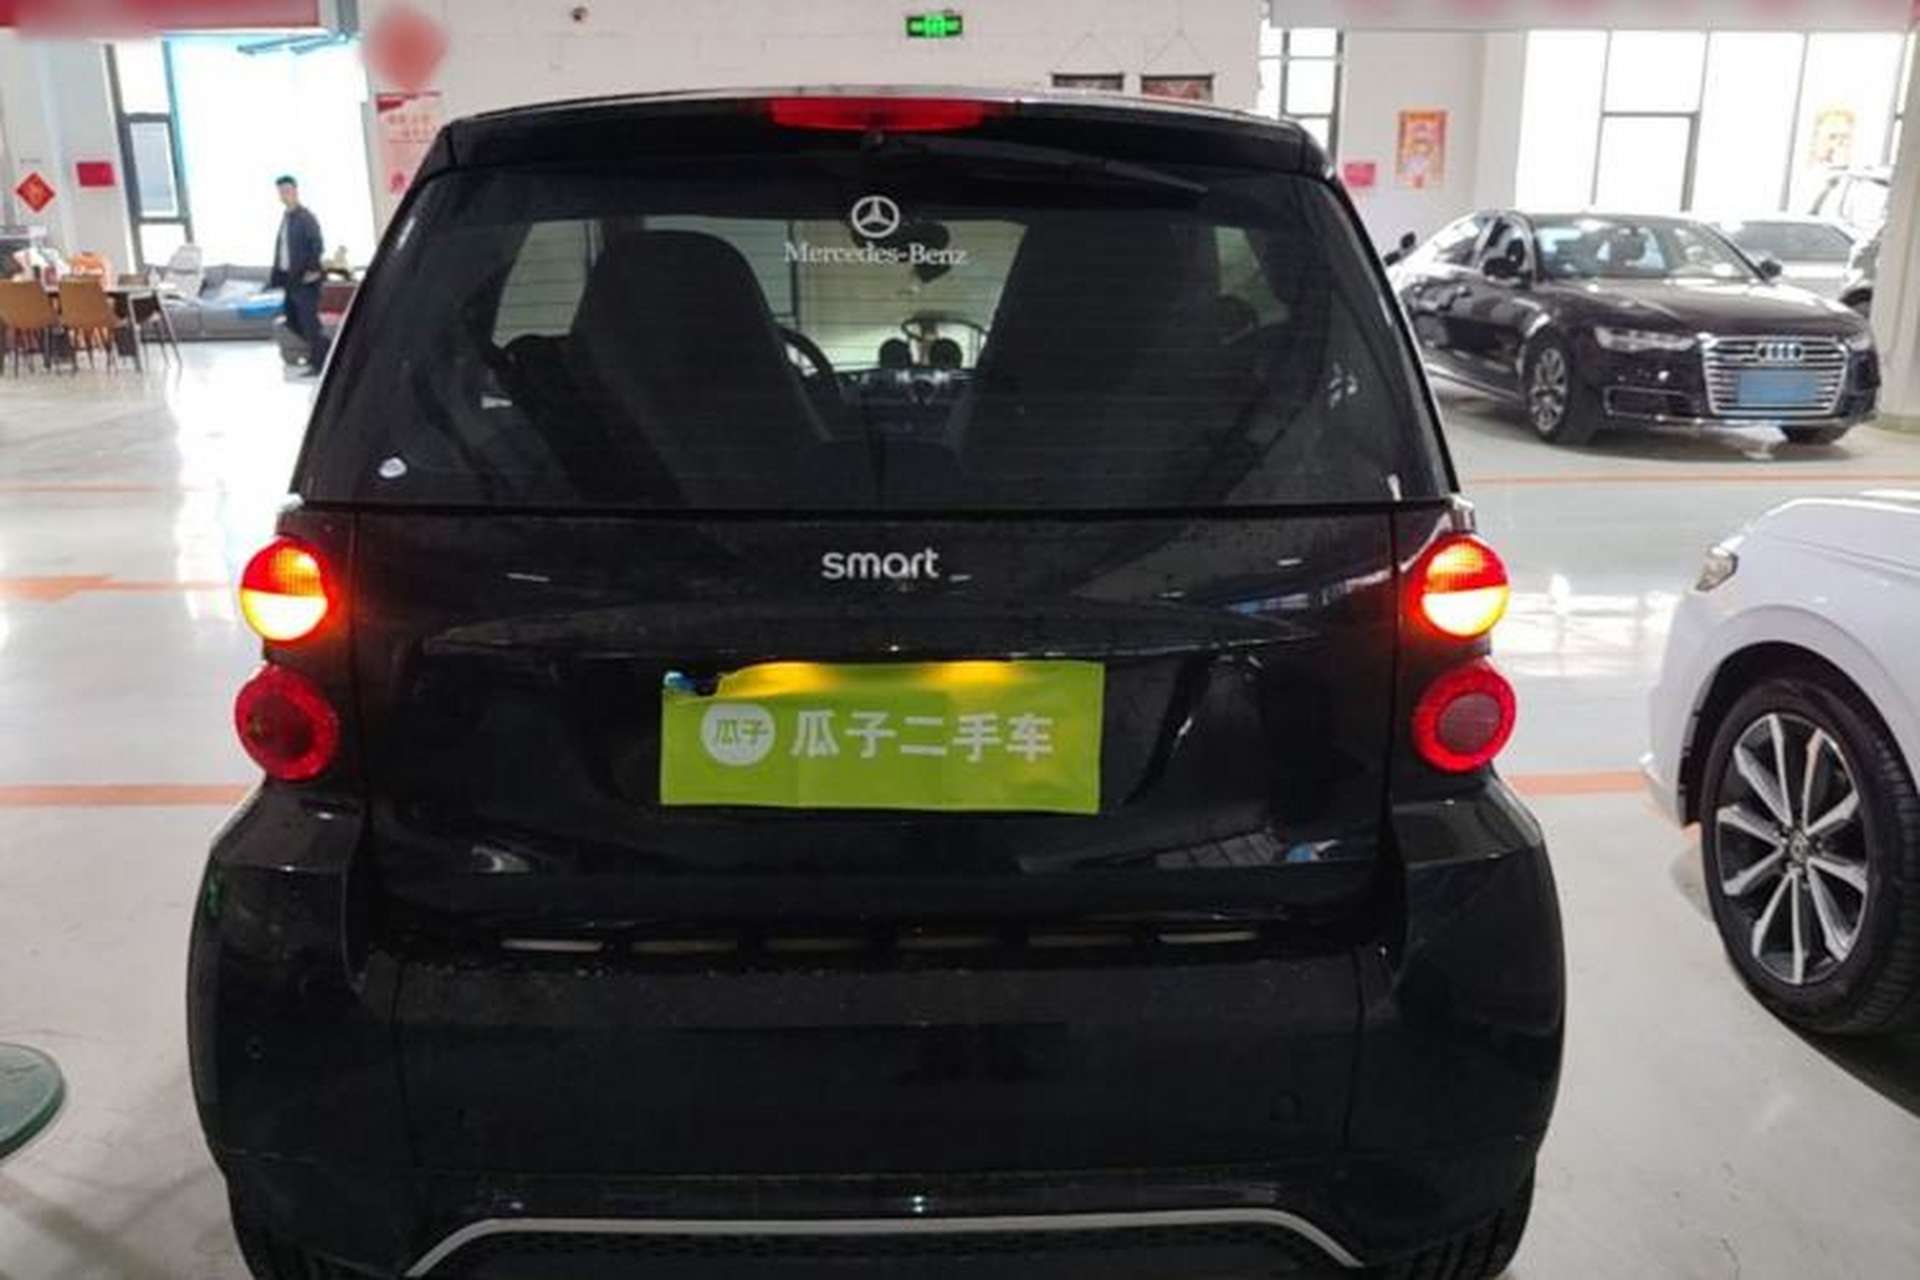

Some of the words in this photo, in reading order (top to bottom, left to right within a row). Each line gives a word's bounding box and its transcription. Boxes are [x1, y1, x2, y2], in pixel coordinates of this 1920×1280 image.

[784, 241, 967, 264] Mercedes-Benz
[821, 547, 939, 579] smart
[716, 717, 770, 745] 瓜子
[790, 709, 1054, 762] 瓜子二手车
